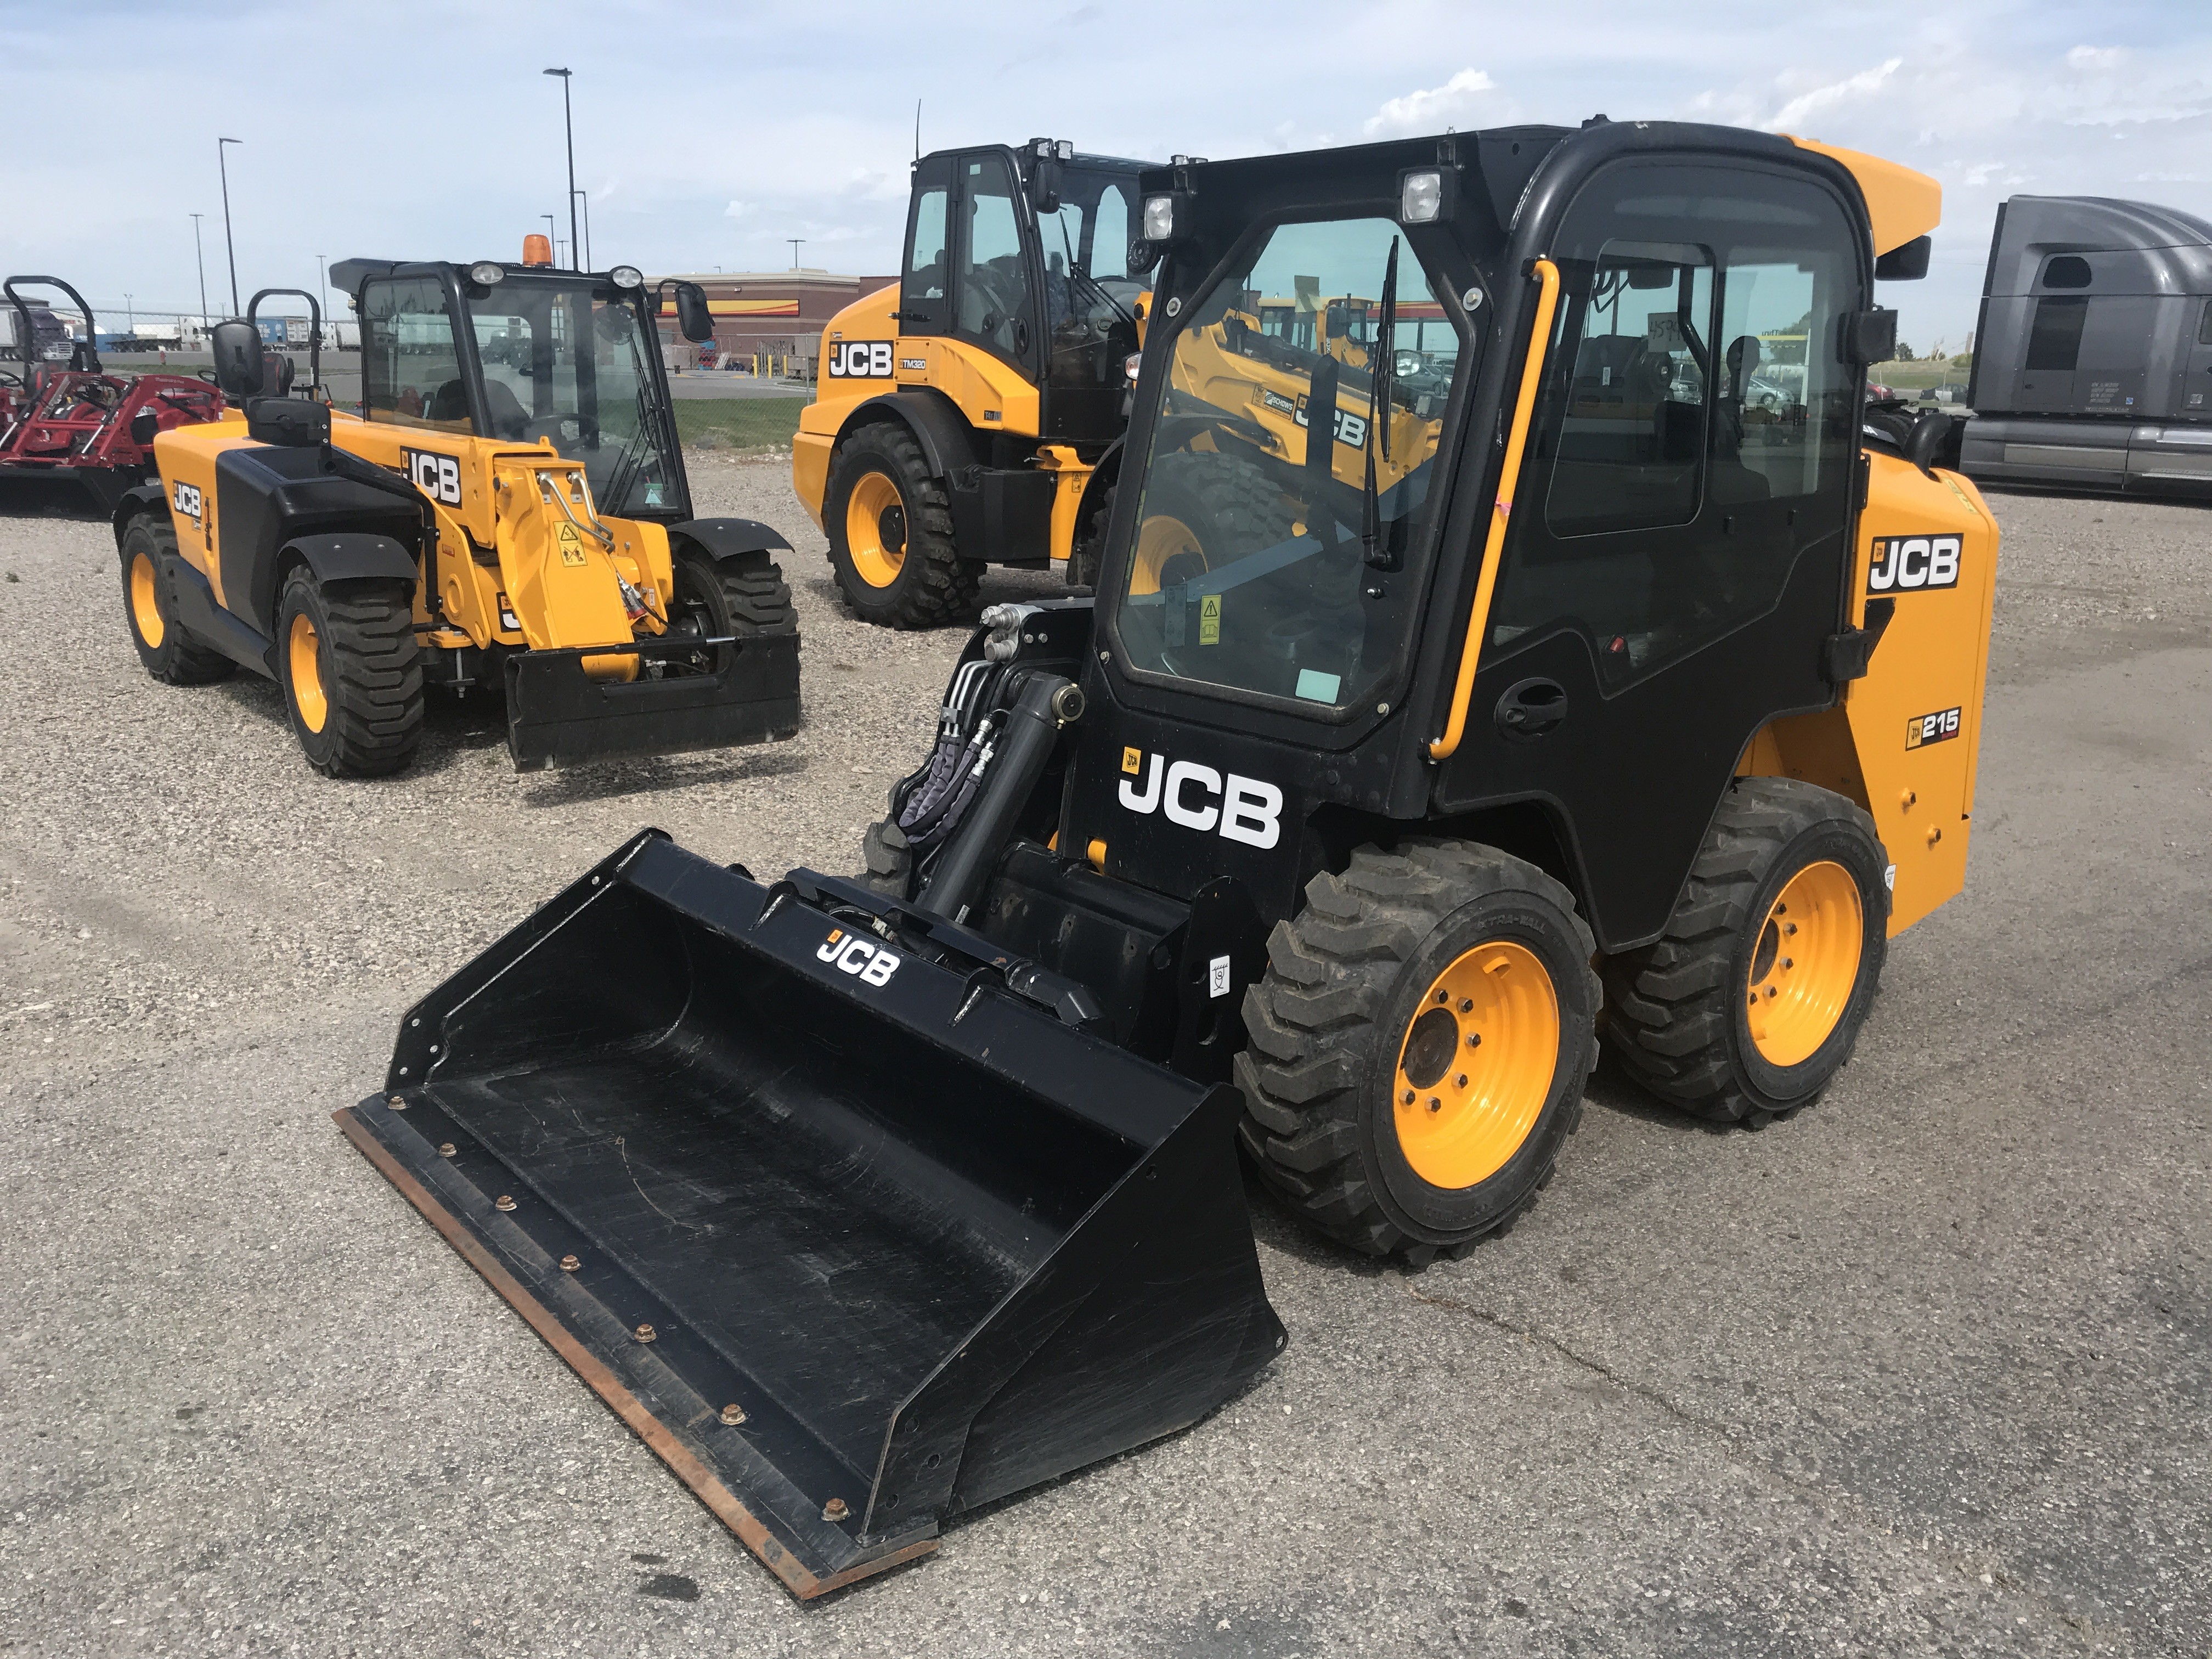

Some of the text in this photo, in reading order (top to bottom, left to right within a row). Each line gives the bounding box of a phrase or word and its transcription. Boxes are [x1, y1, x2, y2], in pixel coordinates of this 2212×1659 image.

[831, 343, 892, 376] JCB
[904, 360, 926, 369] TM320
[1272, 397, 1294, 410] SCHOWS
[403, 453, 460, 504] JCB
[174, 484, 201, 517] JCB
[1870, 538, 1960, 590] JCB
[1922, 709, 1959, 738] 215
[1127, 754, 1137, 766] JCB
[1118, 753, 1283, 850] JCB
[816, 934, 900, 987] JCB
